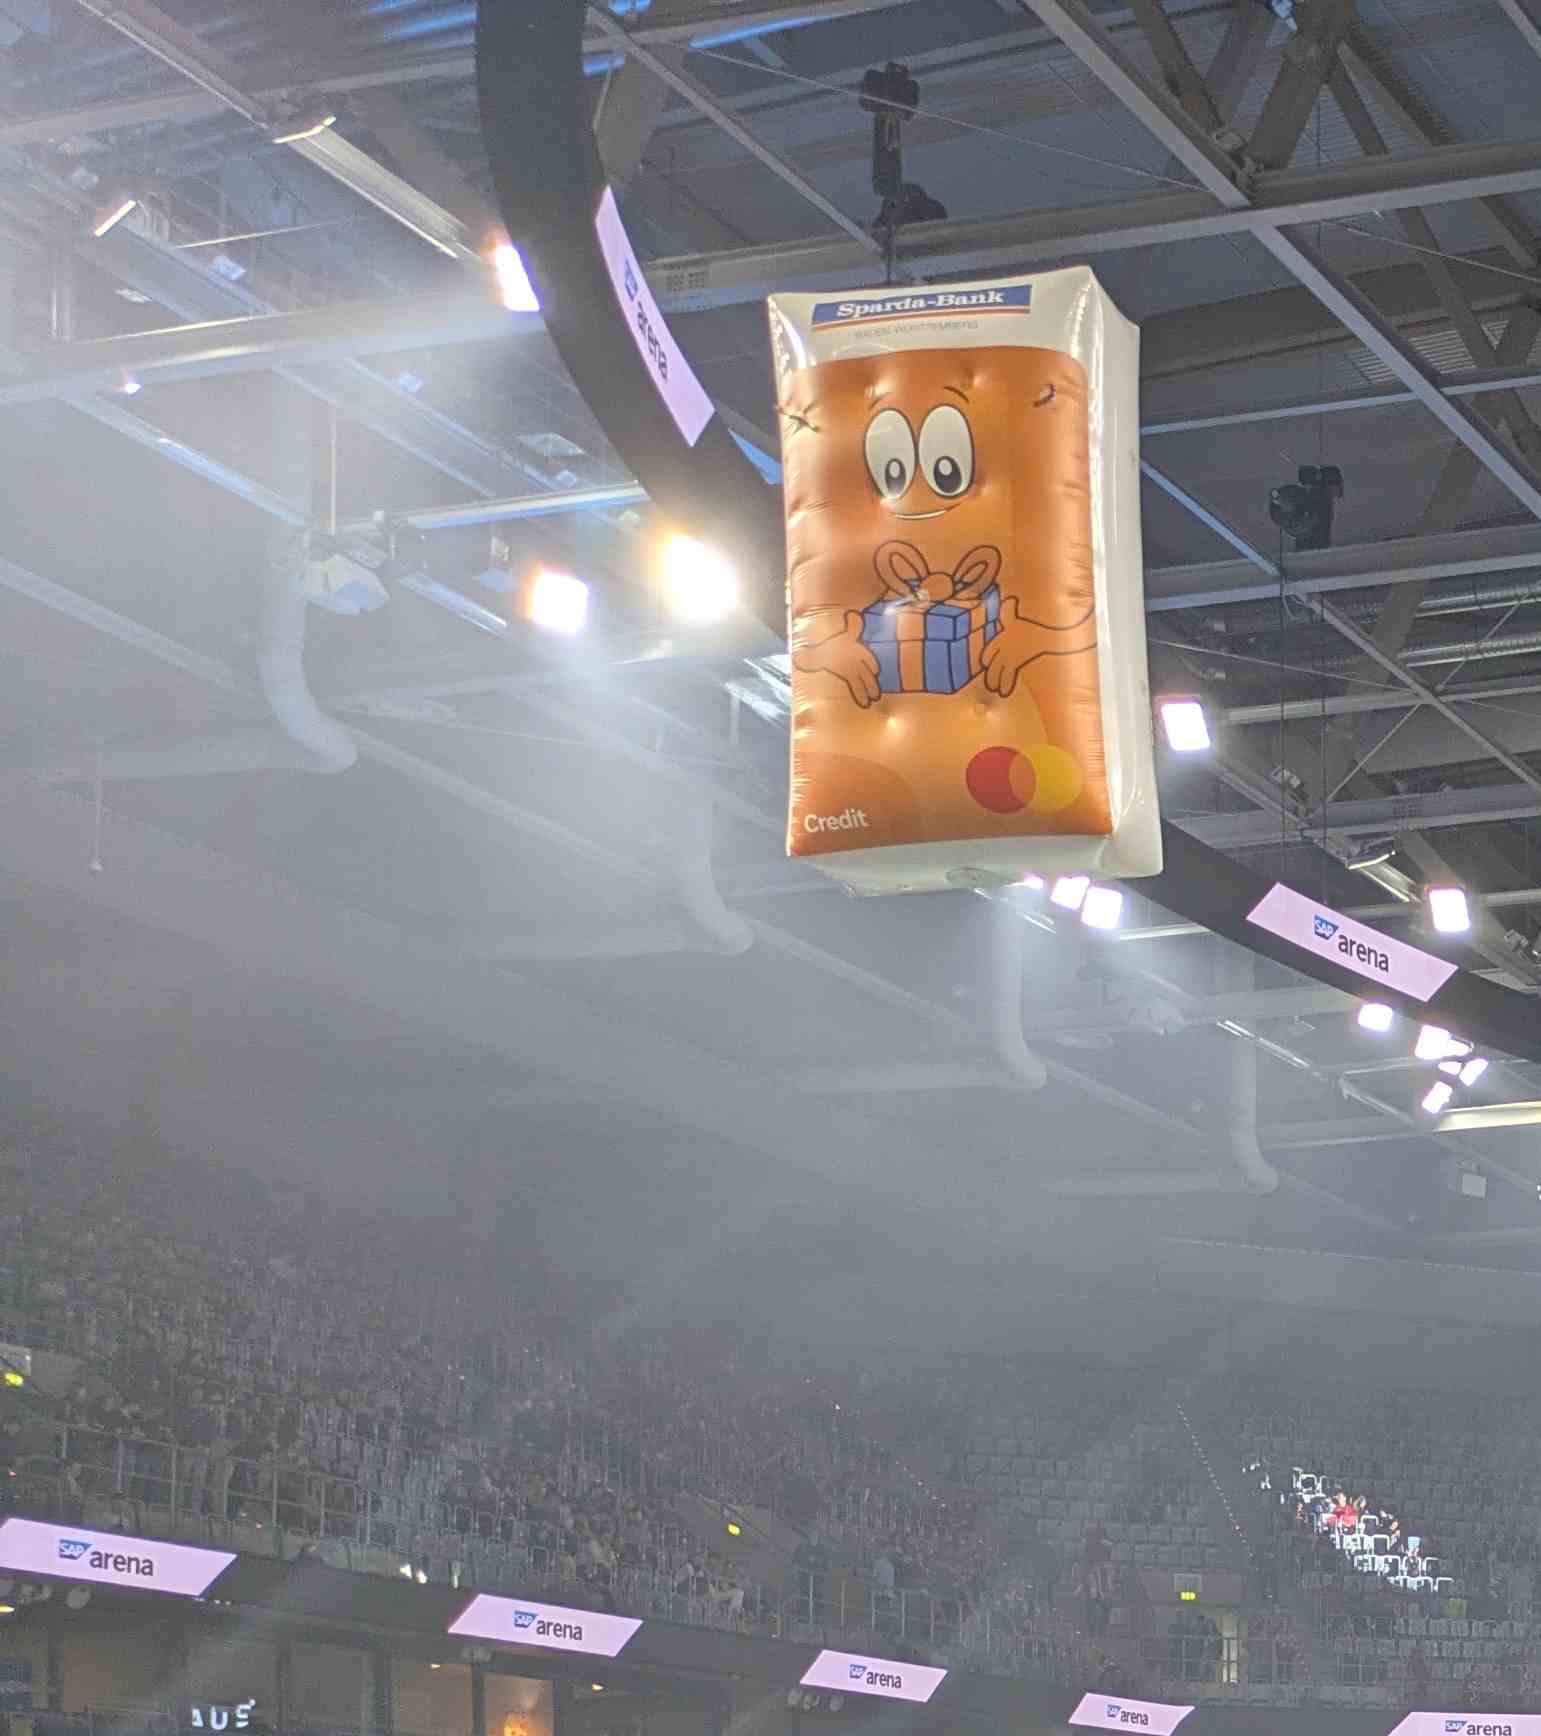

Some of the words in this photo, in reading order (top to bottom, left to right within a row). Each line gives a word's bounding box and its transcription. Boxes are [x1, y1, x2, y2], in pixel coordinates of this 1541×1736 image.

[836, 289, 1005, 319] Sparda-Bank
[635, 302, 669, 380] arena
[803, 807, 869, 833] Credit
[1337, 933, 1390, 974] arena
[59, 1540, 86, 1560] SAP
[88, 1546, 155, 1577] arena
[535, 1617, 583, 1641] arena
[866, 1667, 903, 1690] arena
[1119, 1707, 1150, 1727] arena
